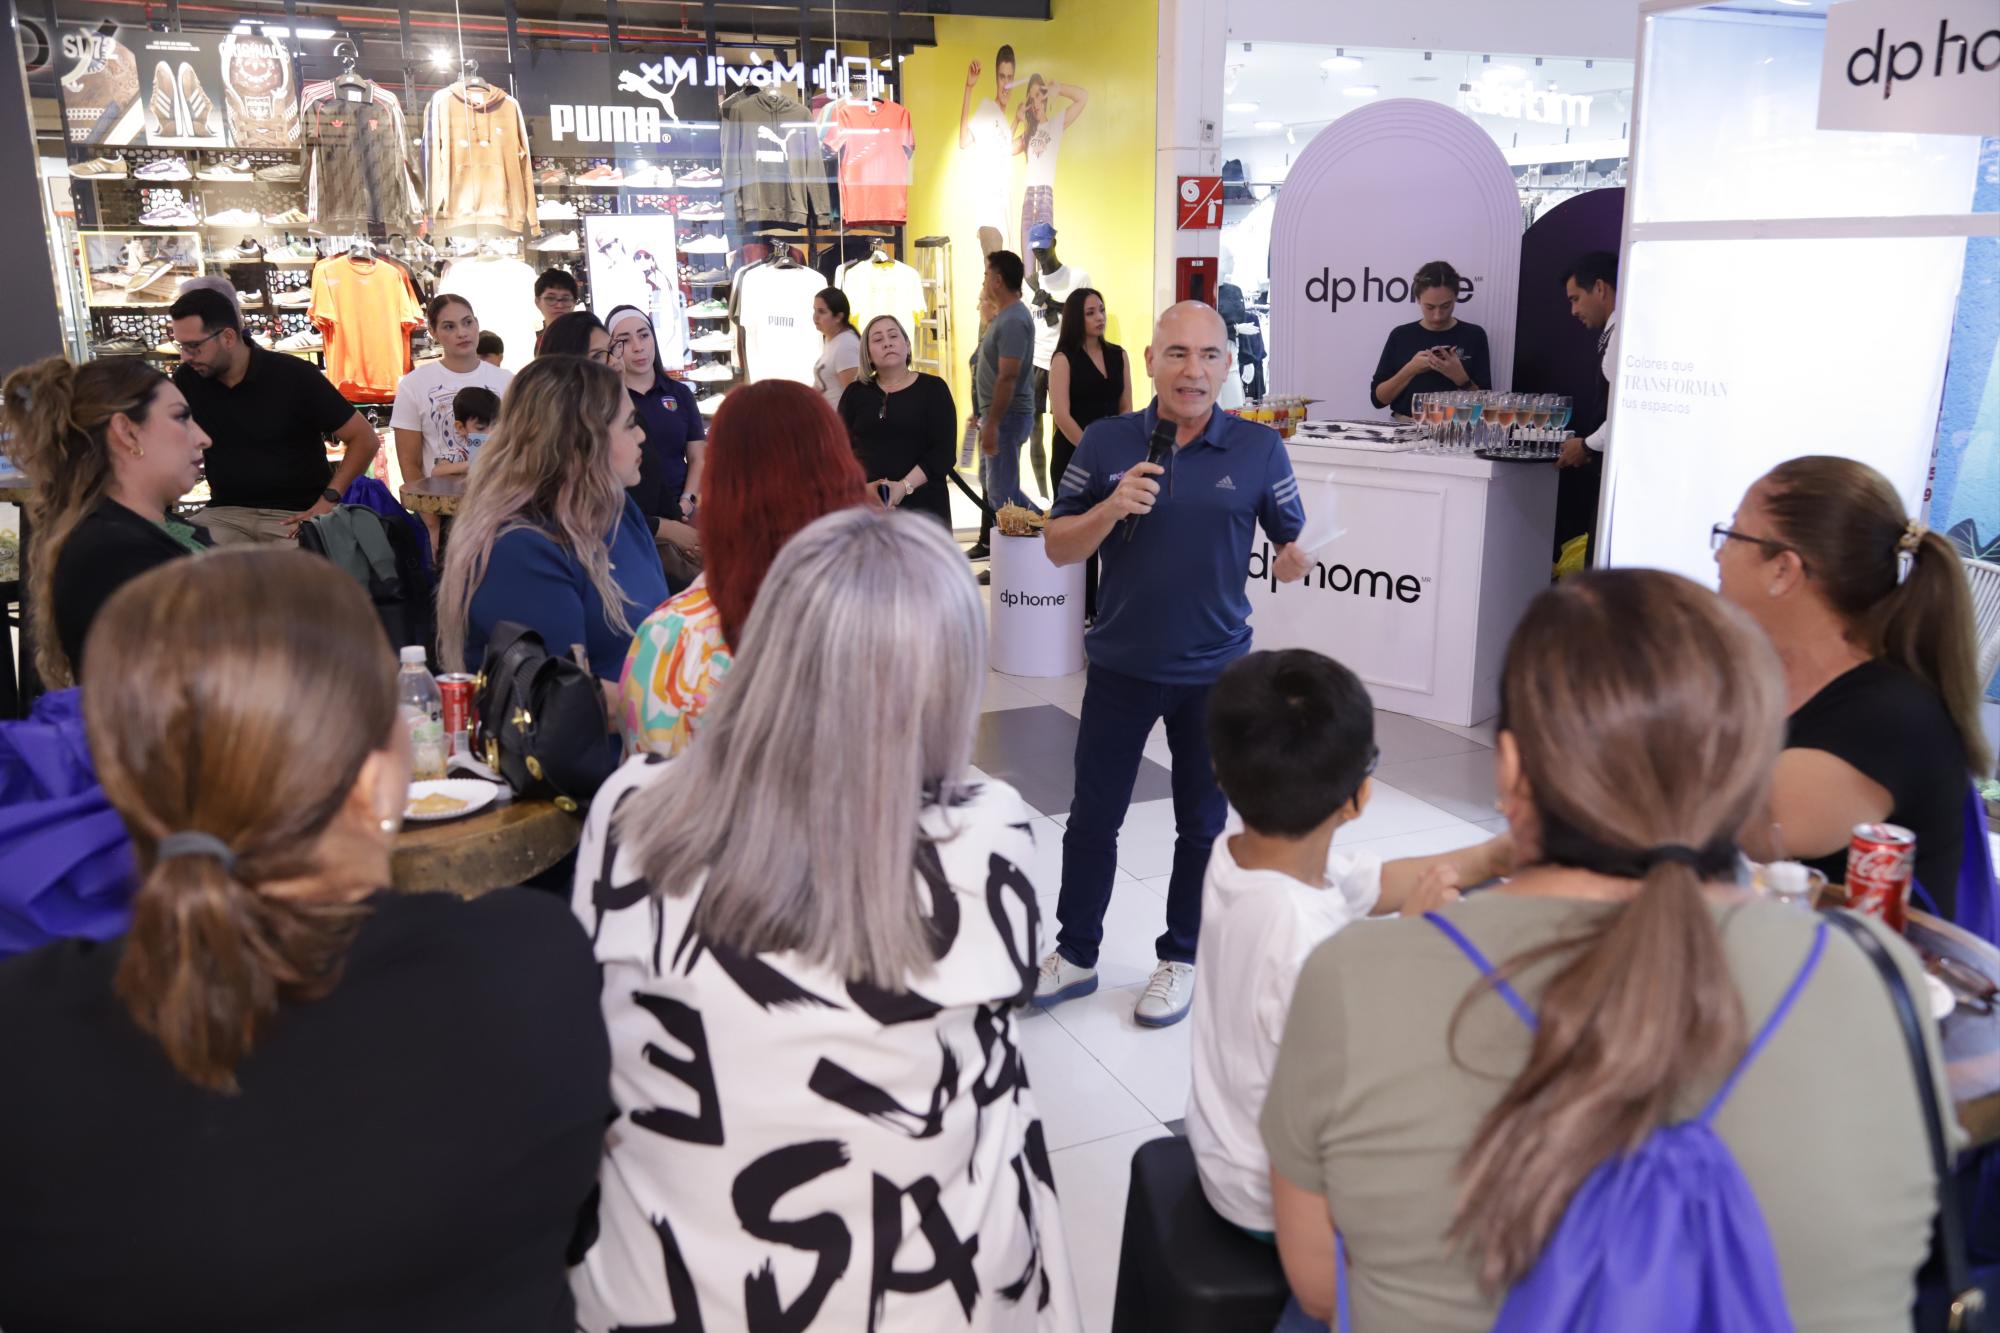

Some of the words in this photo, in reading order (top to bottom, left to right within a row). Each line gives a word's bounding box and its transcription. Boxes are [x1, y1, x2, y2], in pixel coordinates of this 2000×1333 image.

[1847, 27, 1923, 100] dp
[550, 104, 662, 144] PUMA
[1305, 266, 1356, 313] dp
[1363, 266, 1475, 304] hoe
[768, 315, 795, 328] PUMA
[1625, 354, 1668, 370] Colores
[1671, 360, 1695, 374] que
[1000, 588, 1019, 608] dp
[1020, 590, 1066, 607] home
